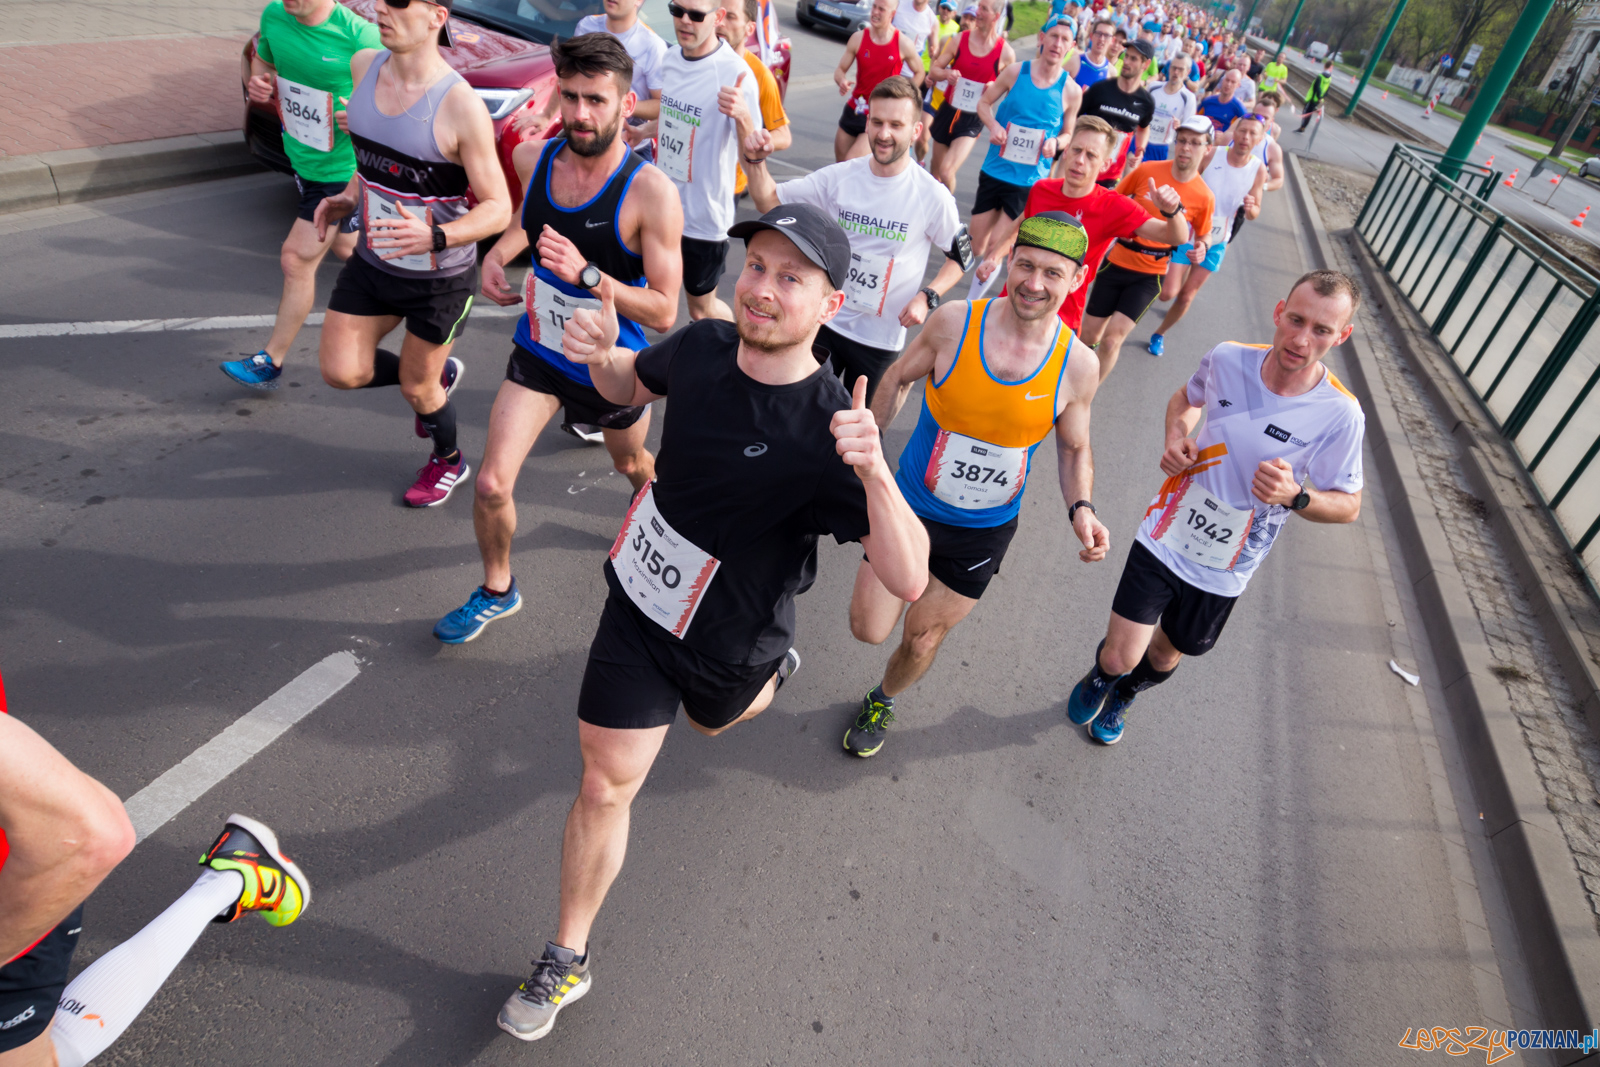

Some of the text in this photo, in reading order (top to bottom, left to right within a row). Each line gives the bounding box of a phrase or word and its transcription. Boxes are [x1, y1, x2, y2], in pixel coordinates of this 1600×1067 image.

[962, 88, 975, 99] 131
[284, 97, 322, 124] 3864
[660, 105, 701, 127] TRITION
[660, 132, 684, 156] 6147
[1012, 136, 1035, 149] 8211
[837, 217, 907, 242] NUTRITION
[838, 208, 909, 233] HERBALIFE
[950, 460, 1008, 487] 3874
[963, 484, 988, 493] Tomasz
[1186, 508, 1234, 545] 1942
[1190, 532, 1213, 548] MACIEJ
[632, 524, 682, 590] 3150
[631, 557, 661, 594] Maximilian
